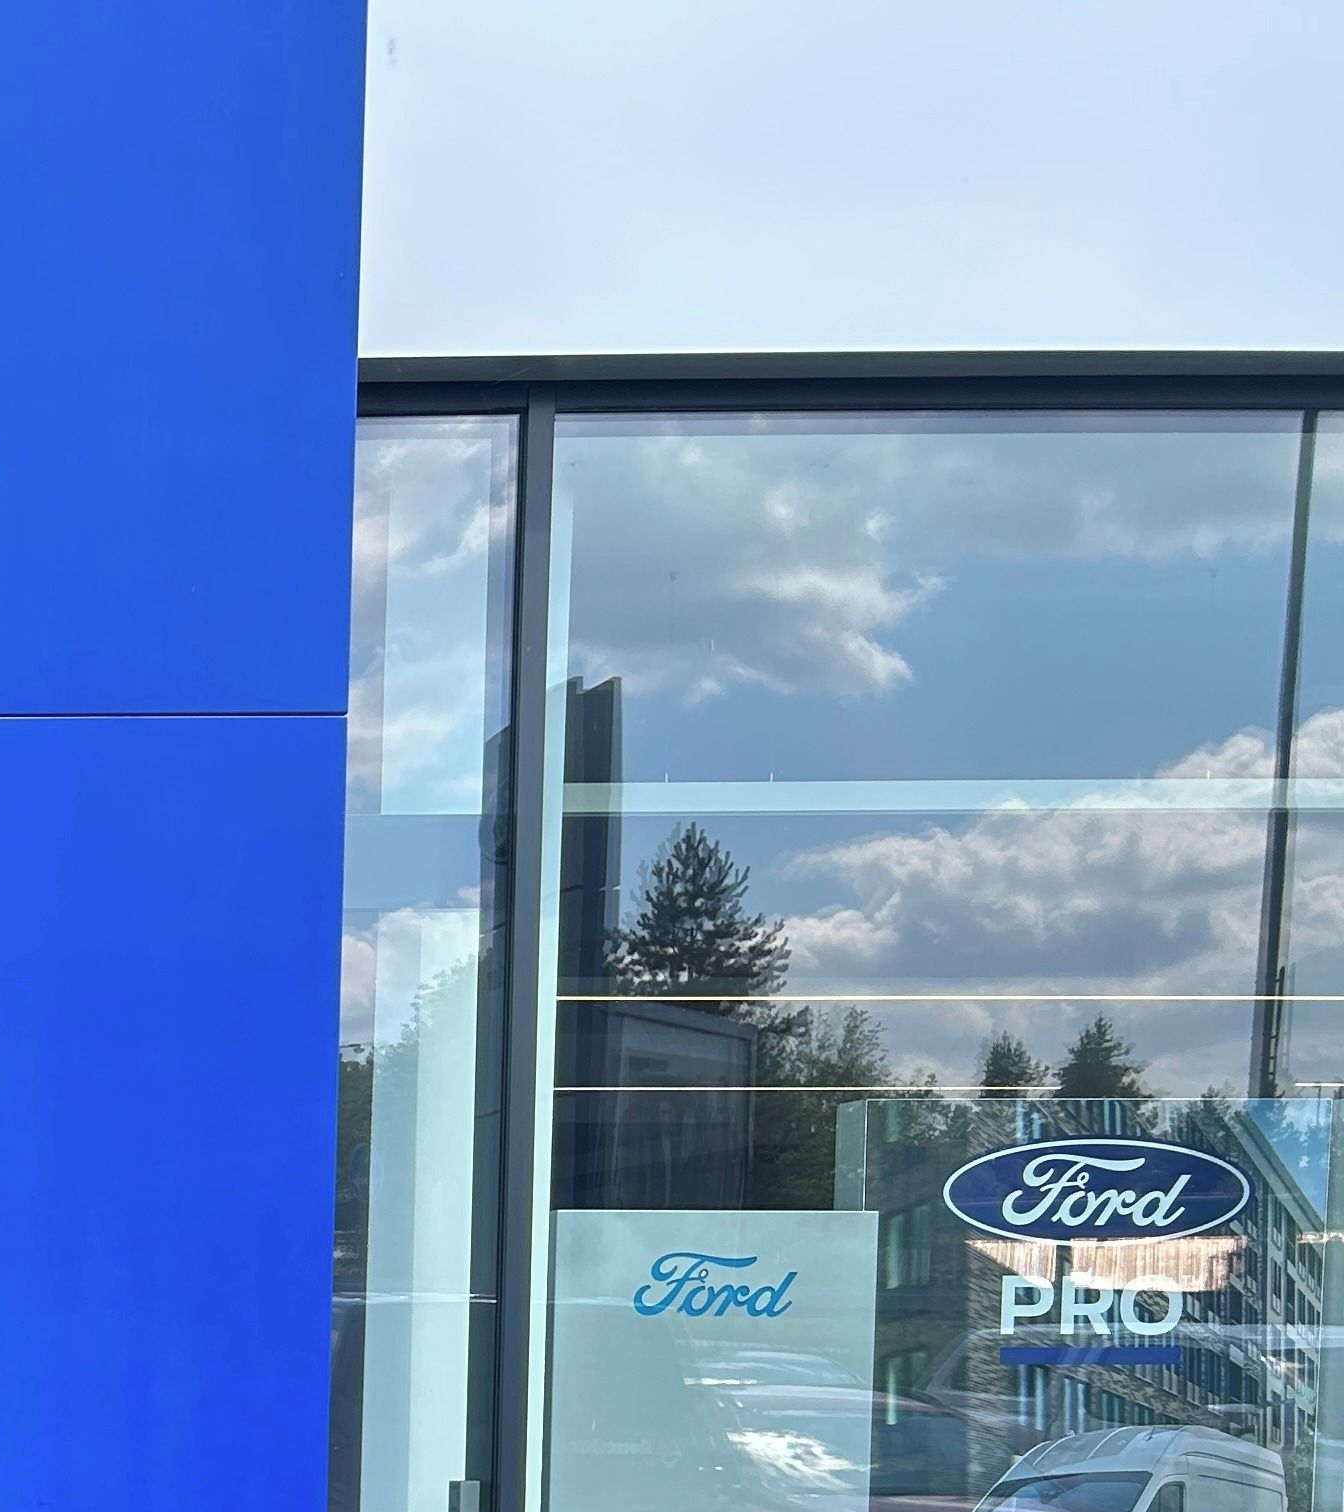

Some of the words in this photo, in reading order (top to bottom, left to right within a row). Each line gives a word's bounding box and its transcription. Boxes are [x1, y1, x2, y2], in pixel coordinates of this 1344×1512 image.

[1002, 1153, 1192, 1227] Ford
[633, 1252, 798, 1317] Ford
[1000, 1274, 1184, 1335] PRO
